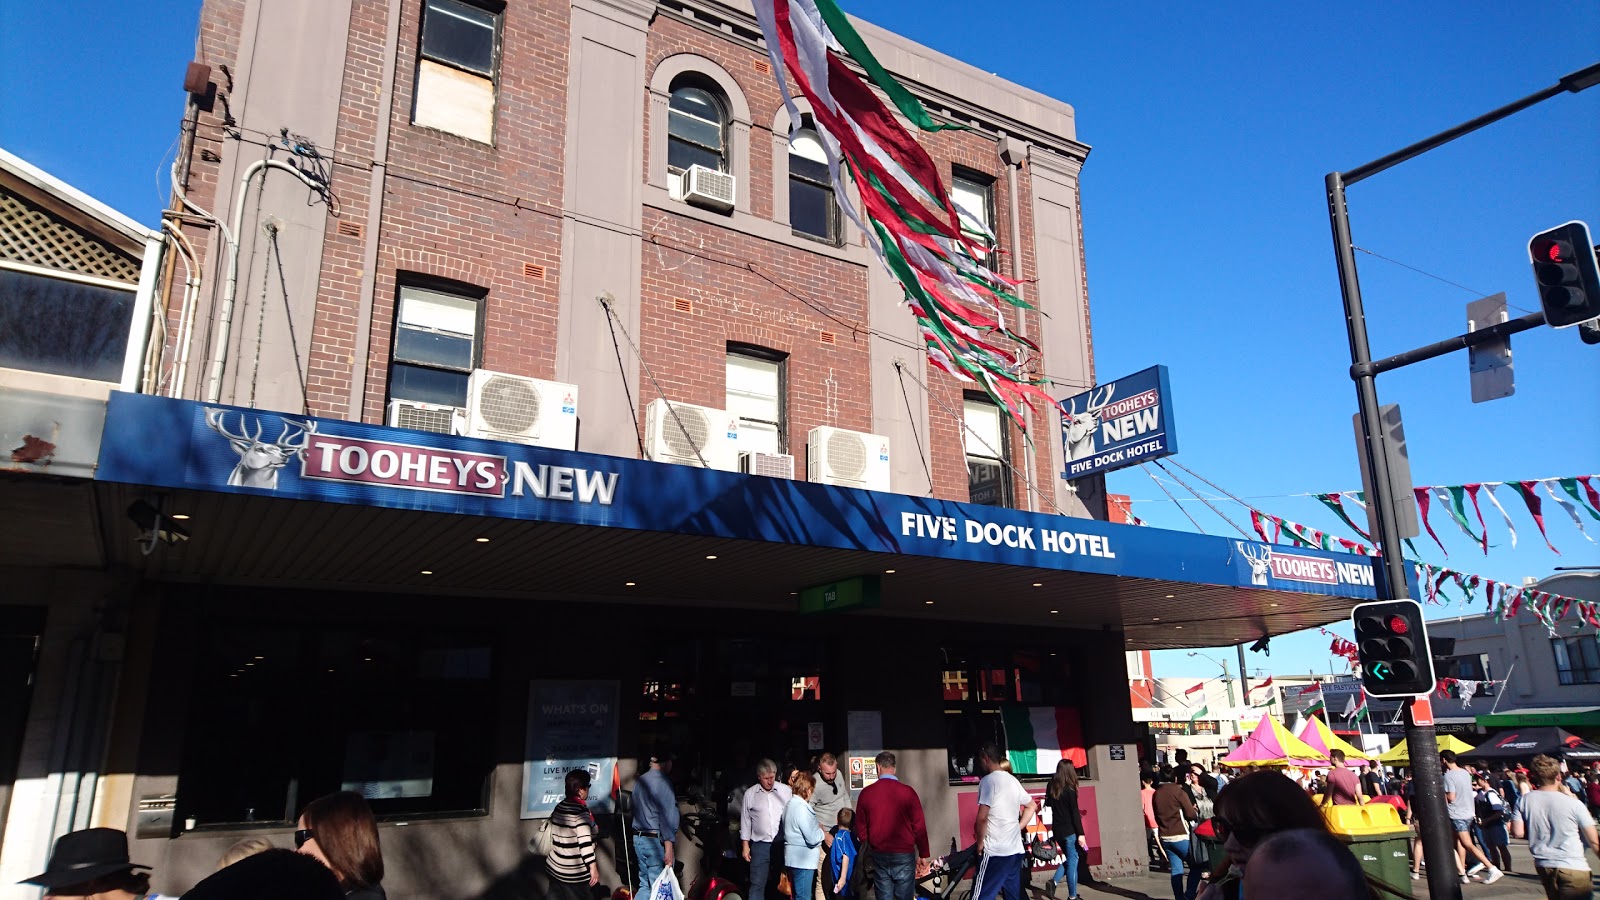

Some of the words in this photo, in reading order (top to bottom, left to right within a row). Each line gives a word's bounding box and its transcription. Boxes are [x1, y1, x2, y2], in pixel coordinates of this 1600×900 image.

[1104, 392, 1155, 418] TOOHEYS
[1102, 405, 1159, 446] NEW
[1071, 462, 1092, 474] FIVE
[1095, 451, 1124, 467] DOCK
[1127, 440, 1163, 458] HOTEL
[315, 442, 497, 489] TOOHEYS
[511, 460, 619, 505] NEW
[901, 511, 958, 541] FIVE
[965, 519, 1036, 550] DOCK
[1041, 528, 1116, 559] HOTEL
[1273, 557, 1336, 580] TOOHEYS
[1336, 562, 1374, 586] NEW
[825, 592, 836, 602] TAB
[542, 704, 587, 715] WHAT'S
[590, 703, 608, 714] ON
[1434, 725, 1465, 733] EWELLERY
[542, 794, 564, 804] UFC
